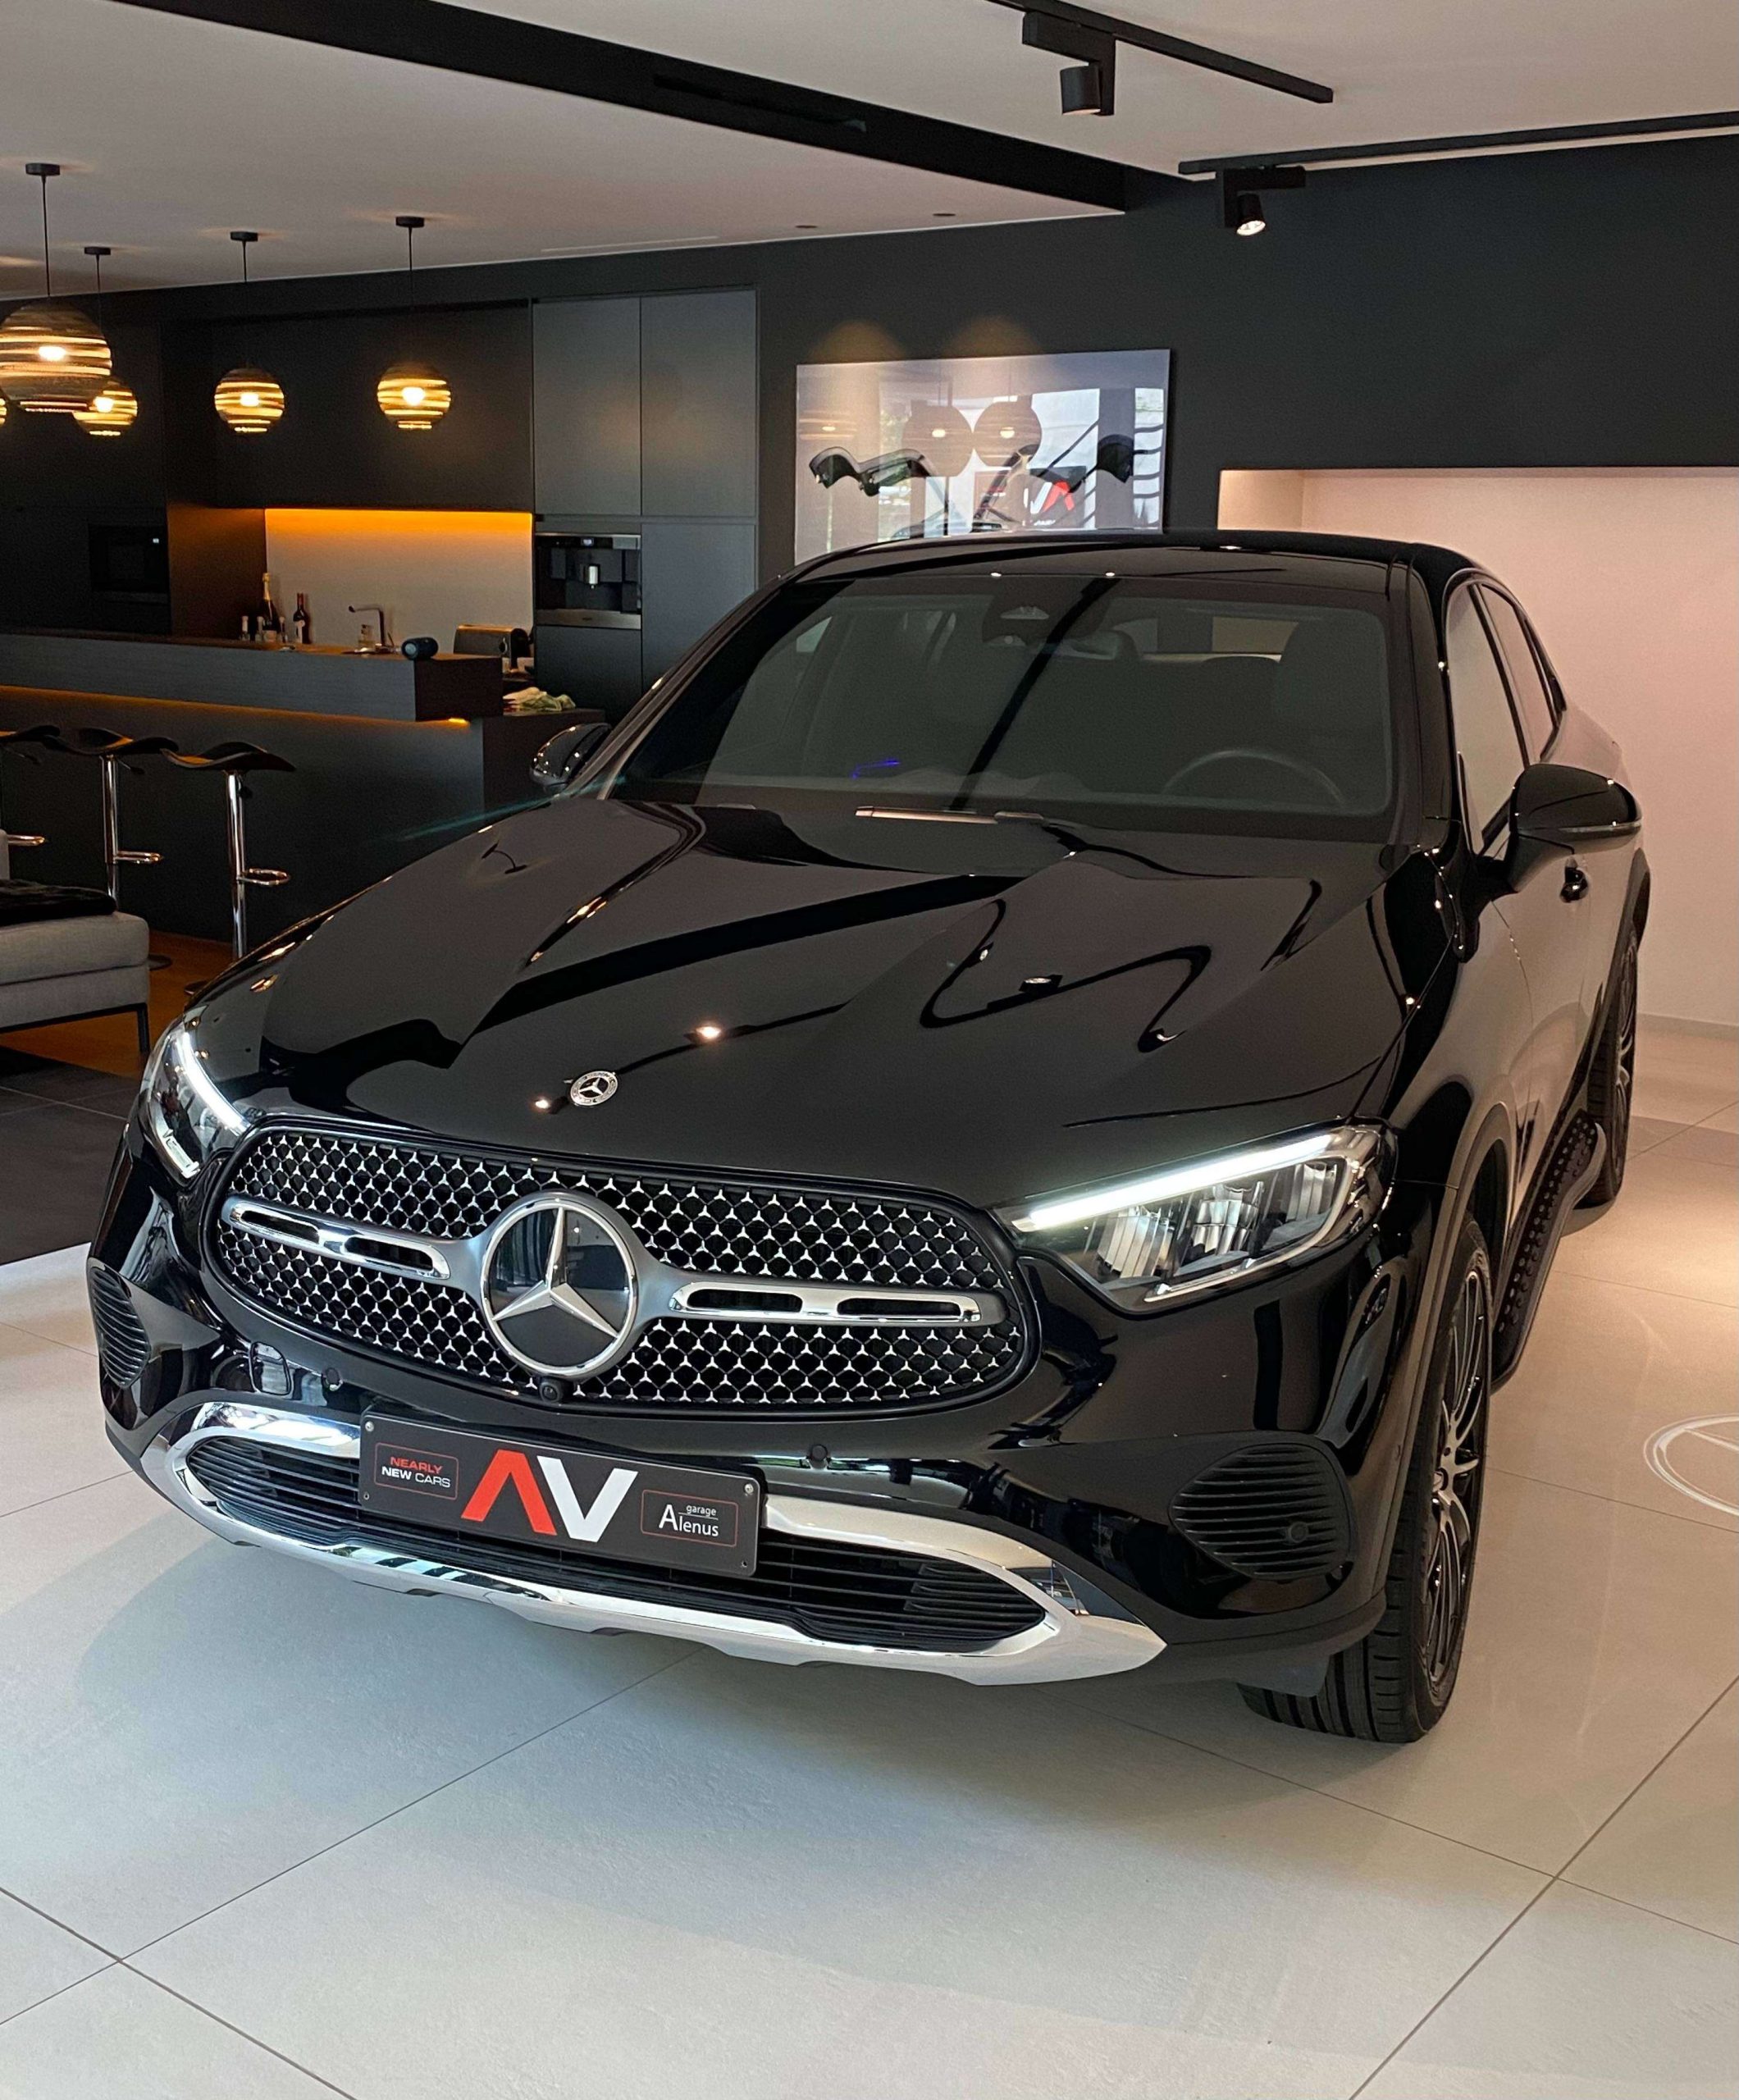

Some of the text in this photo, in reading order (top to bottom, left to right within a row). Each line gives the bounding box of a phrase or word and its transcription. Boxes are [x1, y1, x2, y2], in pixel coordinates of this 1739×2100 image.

[390, 1456, 443, 1474] NEARLY
[381, 1466, 451, 1488] NEW CARS
[659, 1504, 719, 1537] Alenus
[686, 1504, 717, 1518] garage
